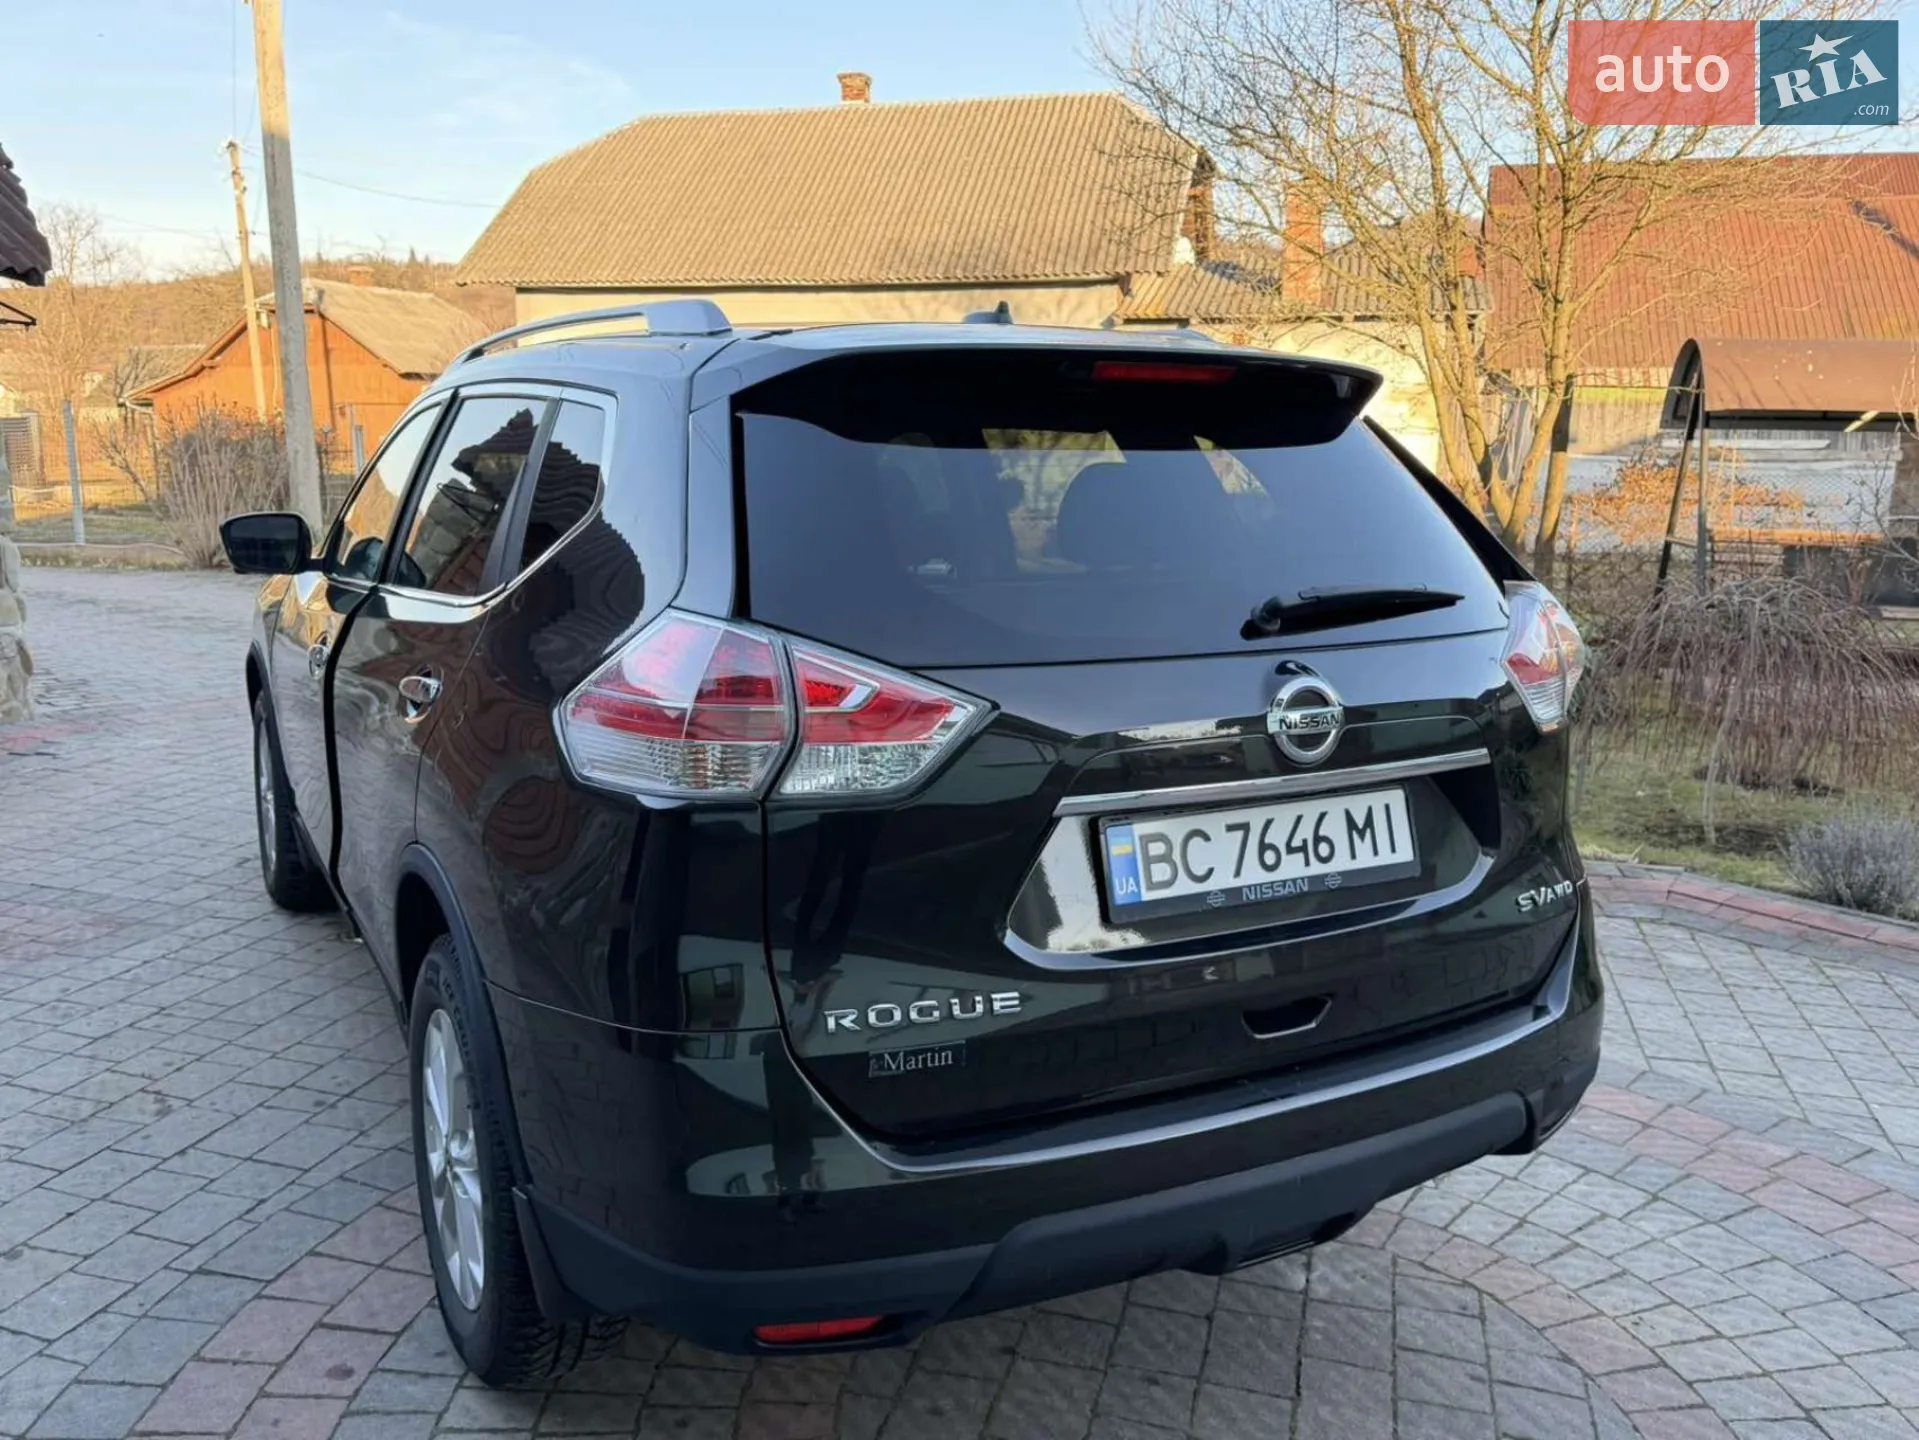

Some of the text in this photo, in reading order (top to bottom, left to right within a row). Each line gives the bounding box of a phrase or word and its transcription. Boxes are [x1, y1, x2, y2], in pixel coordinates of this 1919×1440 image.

[1279, 713, 1339, 730] NISSAN
[1138, 803, 1398, 892] BC 7646 MI
[1114, 877, 1138, 896] UA
[1241, 877, 1309, 901] NISSAN
[823, 991, 1022, 1034] ROGUE
[884, 1047, 954, 1071] Martin
